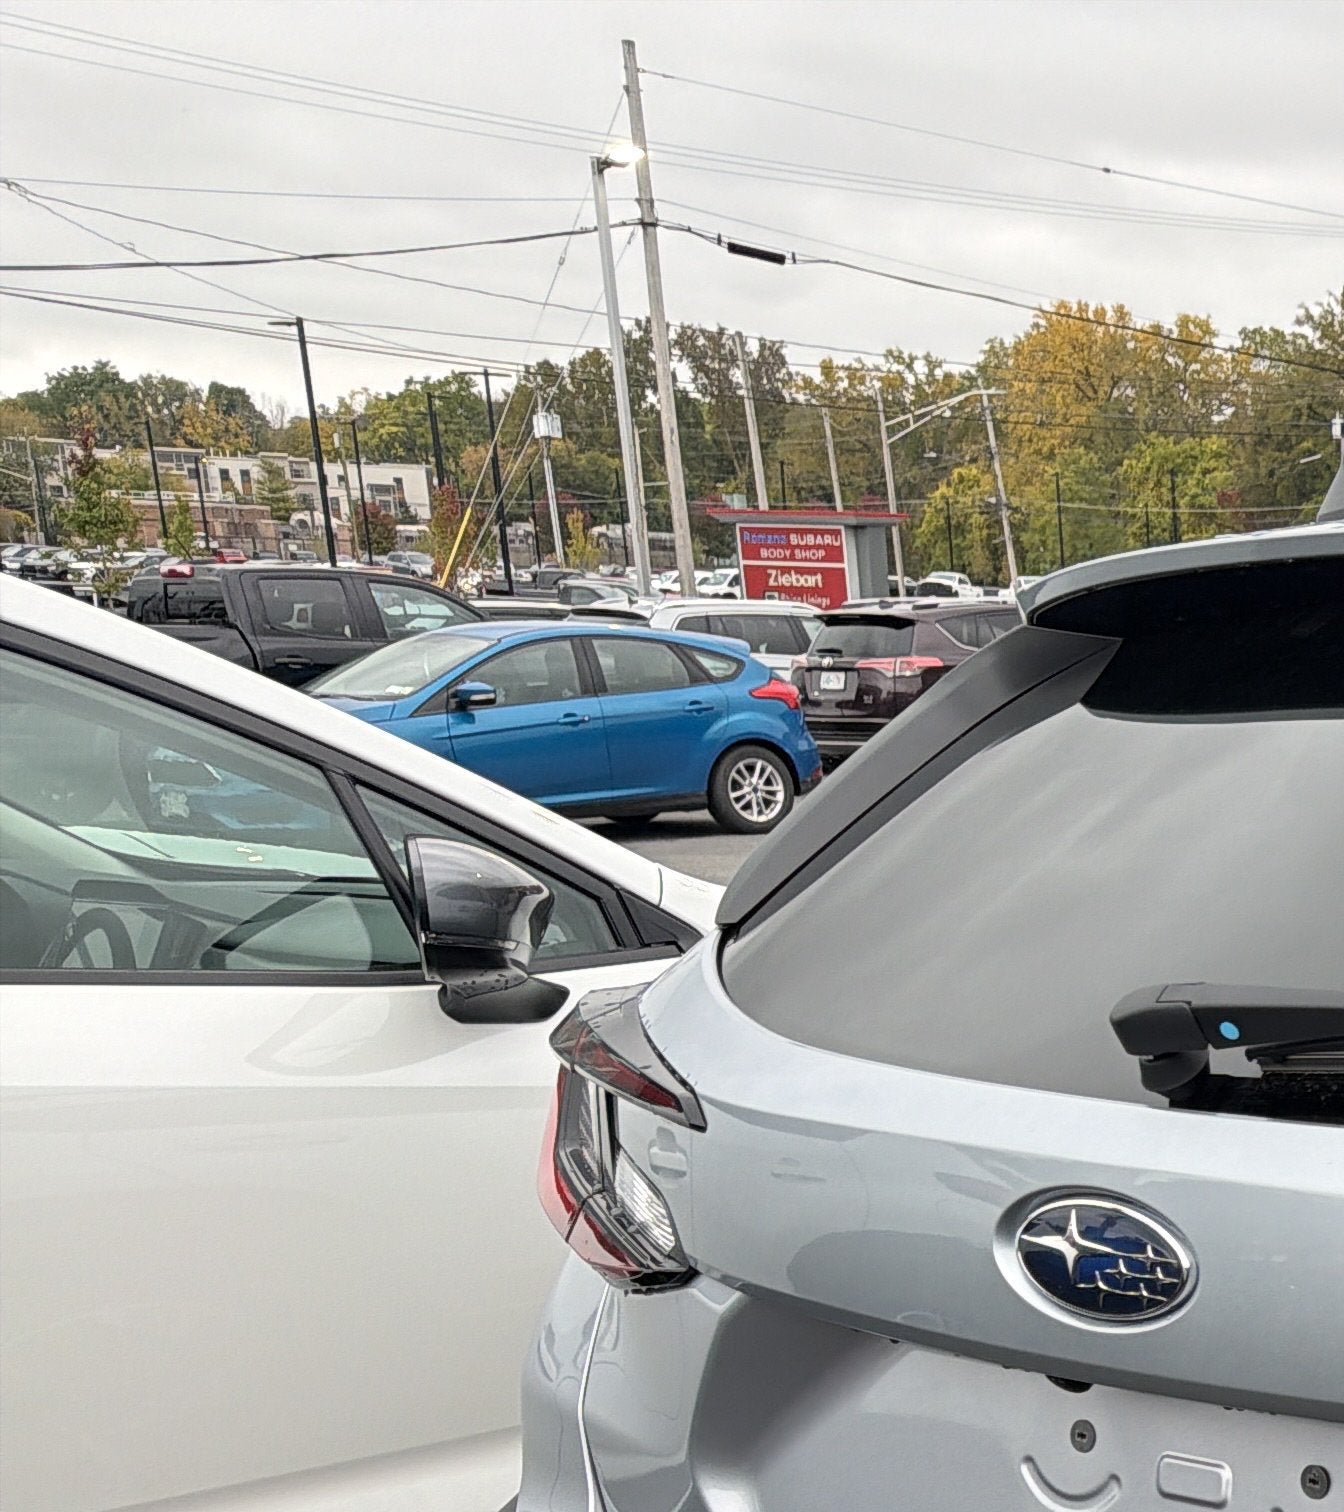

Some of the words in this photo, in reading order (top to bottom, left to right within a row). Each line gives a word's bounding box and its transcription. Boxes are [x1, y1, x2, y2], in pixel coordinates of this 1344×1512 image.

[789, 533, 841, 547] SUBARU
[760, 548, 791, 559] BODY
[794, 549, 826, 560] SHOP
[767, 569, 823, 588] Ziebart
